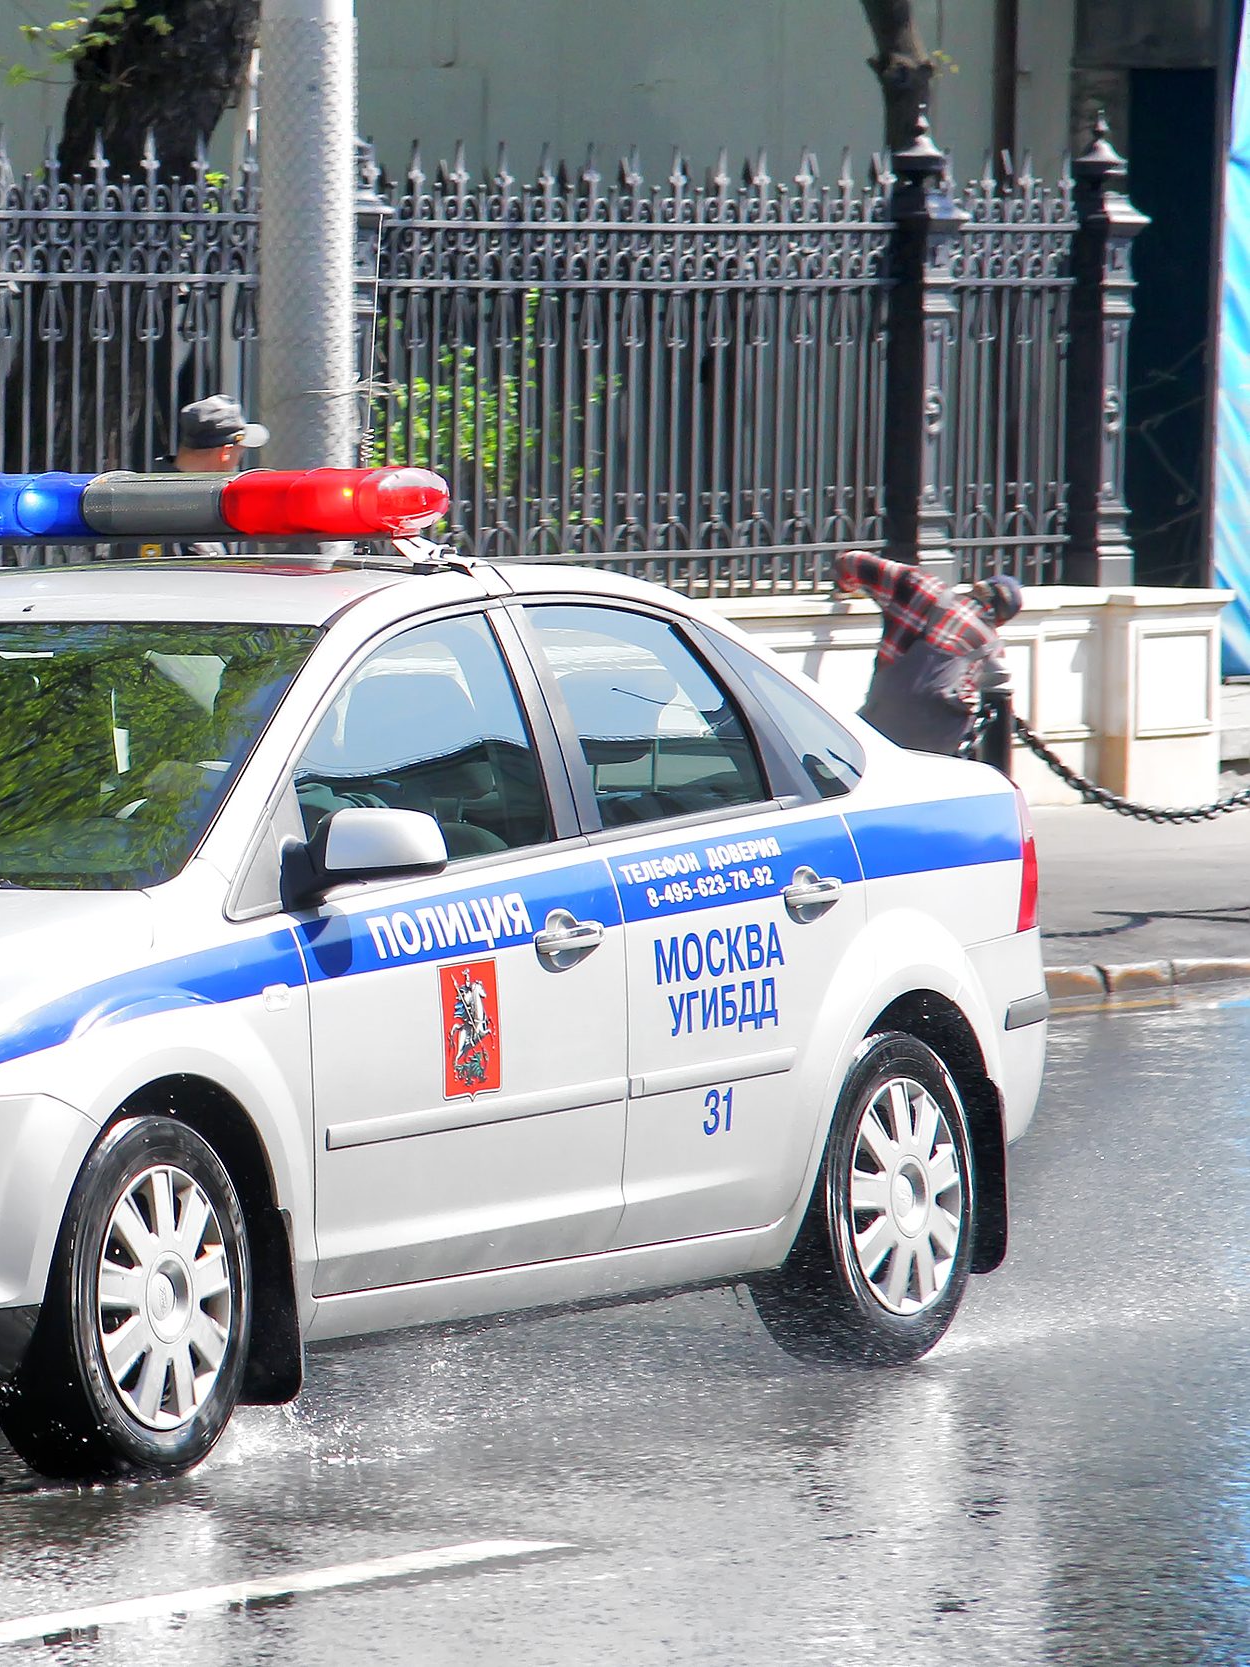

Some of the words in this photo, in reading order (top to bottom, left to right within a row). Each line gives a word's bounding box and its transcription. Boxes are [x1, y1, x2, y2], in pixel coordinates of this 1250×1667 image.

[618, 852, 701, 885] ТЕЛЕФОН
[707, 836, 782, 871] ДОВЕРИЯ
[646, 865, 775, 908] 8-495-623-78-92
[365, 892, 533, 960] ПОЛИЦИЯ
[653, 921, 785, 986] МОСКВА
[667, 977, 779, 1037] УГИБДД
[702, 1086, 734, 1136] 31
